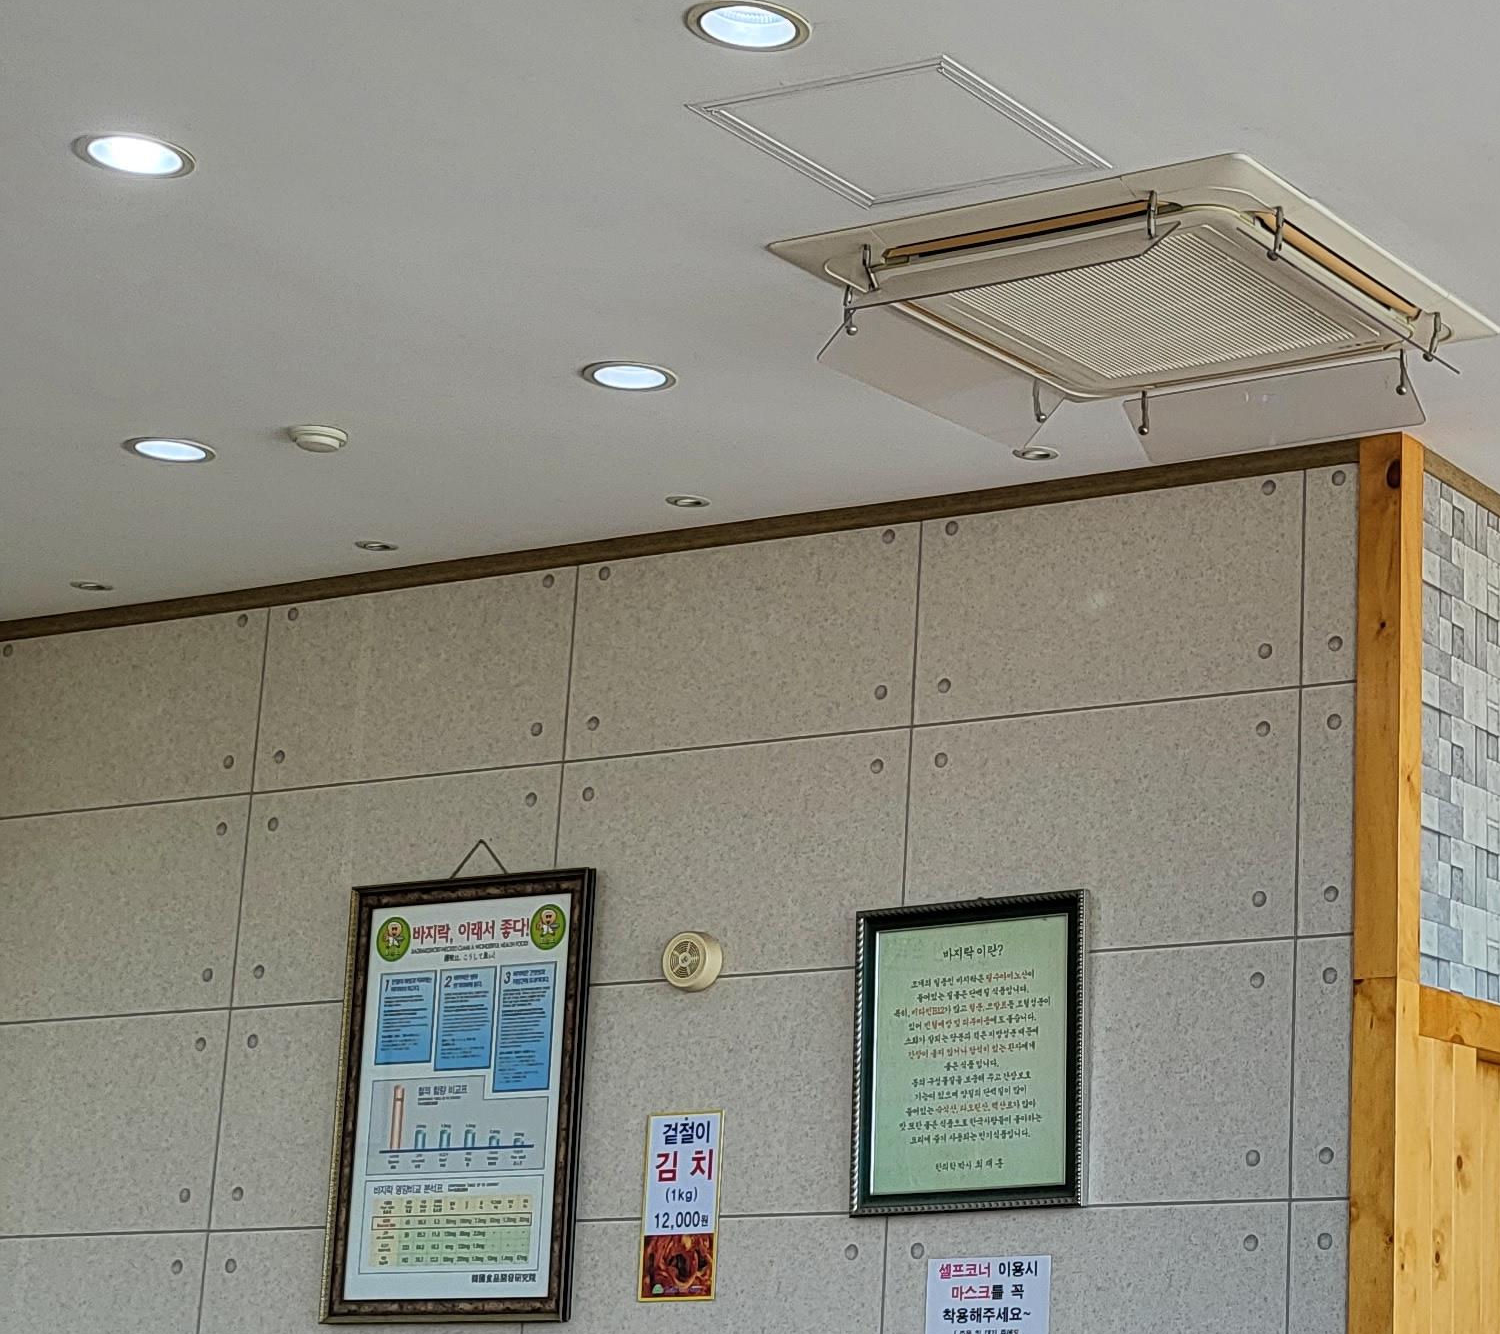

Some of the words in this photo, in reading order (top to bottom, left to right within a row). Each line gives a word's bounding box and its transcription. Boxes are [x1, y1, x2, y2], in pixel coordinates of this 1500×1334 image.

[412, 924, 453, 945] 바지락,
[458, 920, 496, 941] 이래서
[501, 918, 530, 939] 좋다!
[943, 946, 974, 961] 바지락
[976, 944, 1004, 958] 이란?
[385, 979, 390, 992] 1
[444, 976, 452, 987] 2
[504, 972, 511, 984] 3
[663, 1121, 711, 1145] 겉절이
[655, 1148, 714, 1182] 김치
[665, 1187, 698, 1203] (1kg)
[654, 1211, 709, 1230] 12,000원
[939, 1262, 991, 1279] 셀프코너
[999, 1260, 1038, 1277] 이용시
[951, 1284, 1004, 1301] 마스크를
[1011, 1284, 1024, 1299] 꼭
[942, 1307, 1031, 1324] 착용해주세요~
